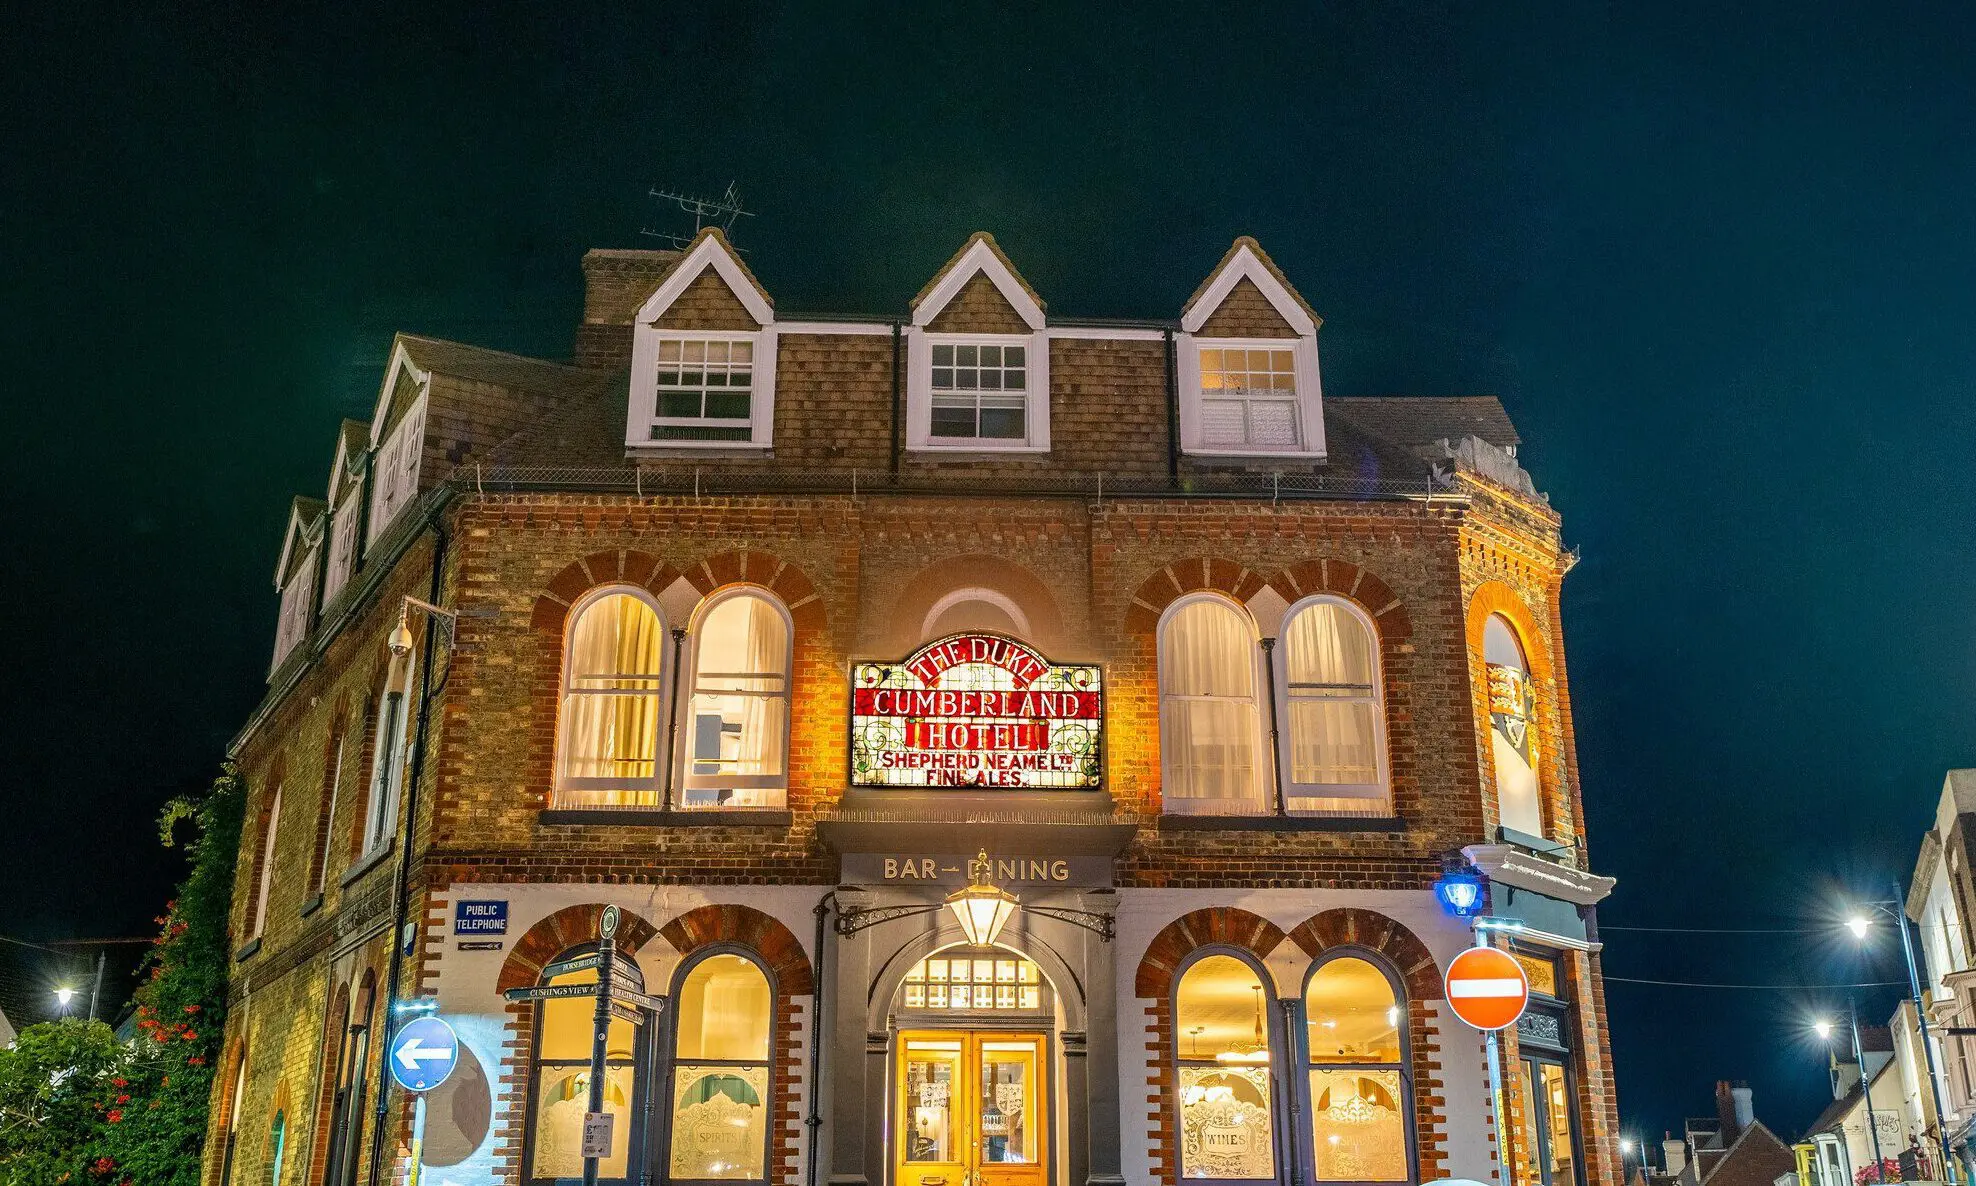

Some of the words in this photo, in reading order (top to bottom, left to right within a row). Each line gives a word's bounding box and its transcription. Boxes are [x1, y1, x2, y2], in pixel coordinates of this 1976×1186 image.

[909, 640, 967, 680] THE
[970, 638, 1041, 684] DUKE
[874, 691, 1080, 717] CUMBERLAND
[928, 724, 1029, 750] HOTEL
[882, 753, 979, 769] SHEPHERD
[986, 753, 1048, 770] NEAME
[926, 769, 967, 786] FINE
[884, 858, 937, 879] BAR
[466, 905, 497, 915] PUBLIC
[457, 919, 506, 930] TELEPHONE
[530, 987, 567, 997] CUSHINGS
[568, 986, 589, 996] VIEW
[700, 1132, 738, 1143] SPIRITS
[1207, 1134, 1246, 1145] WINES
